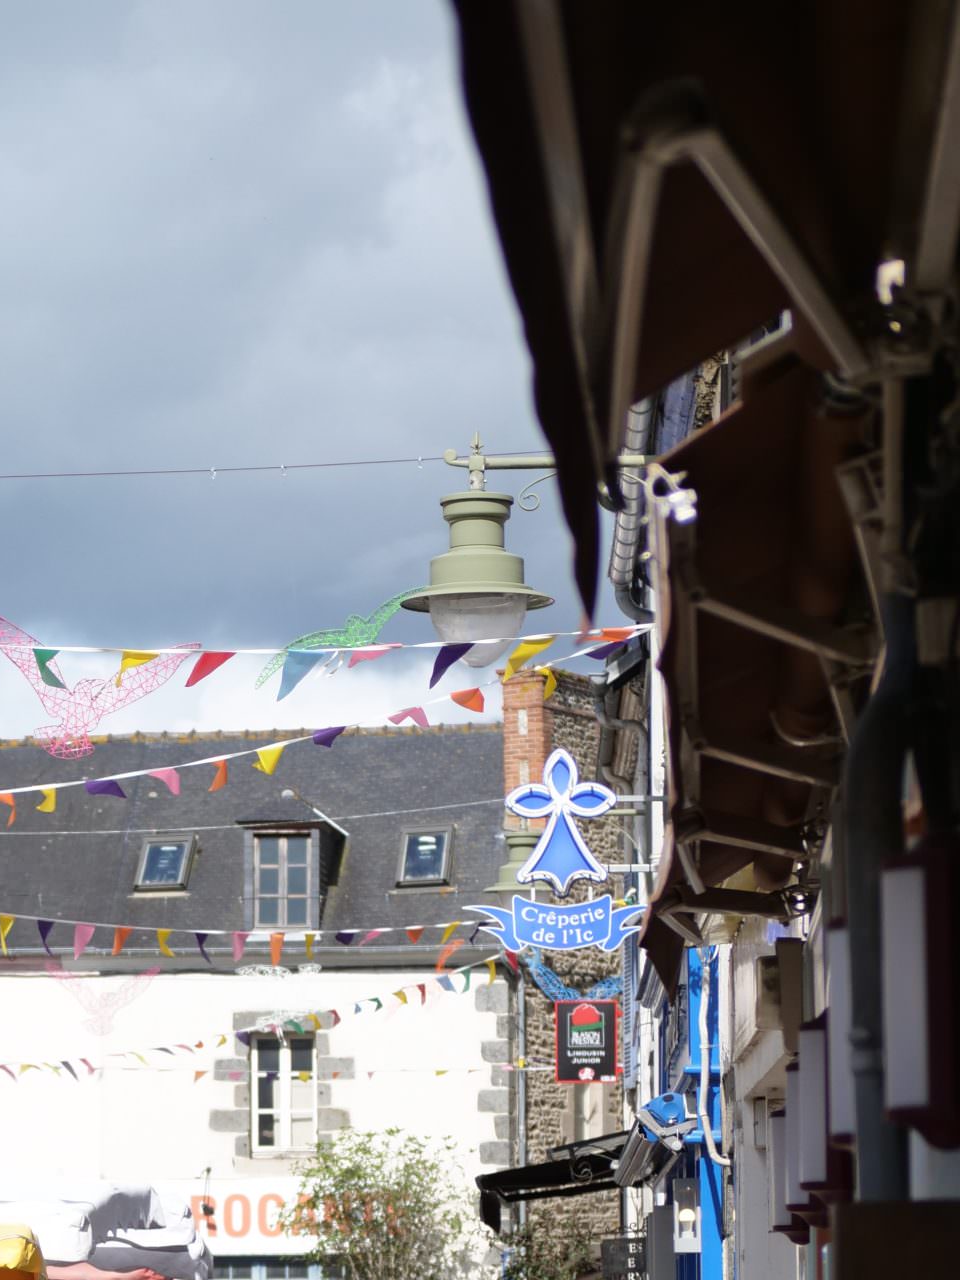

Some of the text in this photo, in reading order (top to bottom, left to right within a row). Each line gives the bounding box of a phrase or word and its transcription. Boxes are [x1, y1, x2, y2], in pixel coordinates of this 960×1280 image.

[521, 907, 605, 928] Crêperie
[532, 929, 594, 944] de l'Ic
